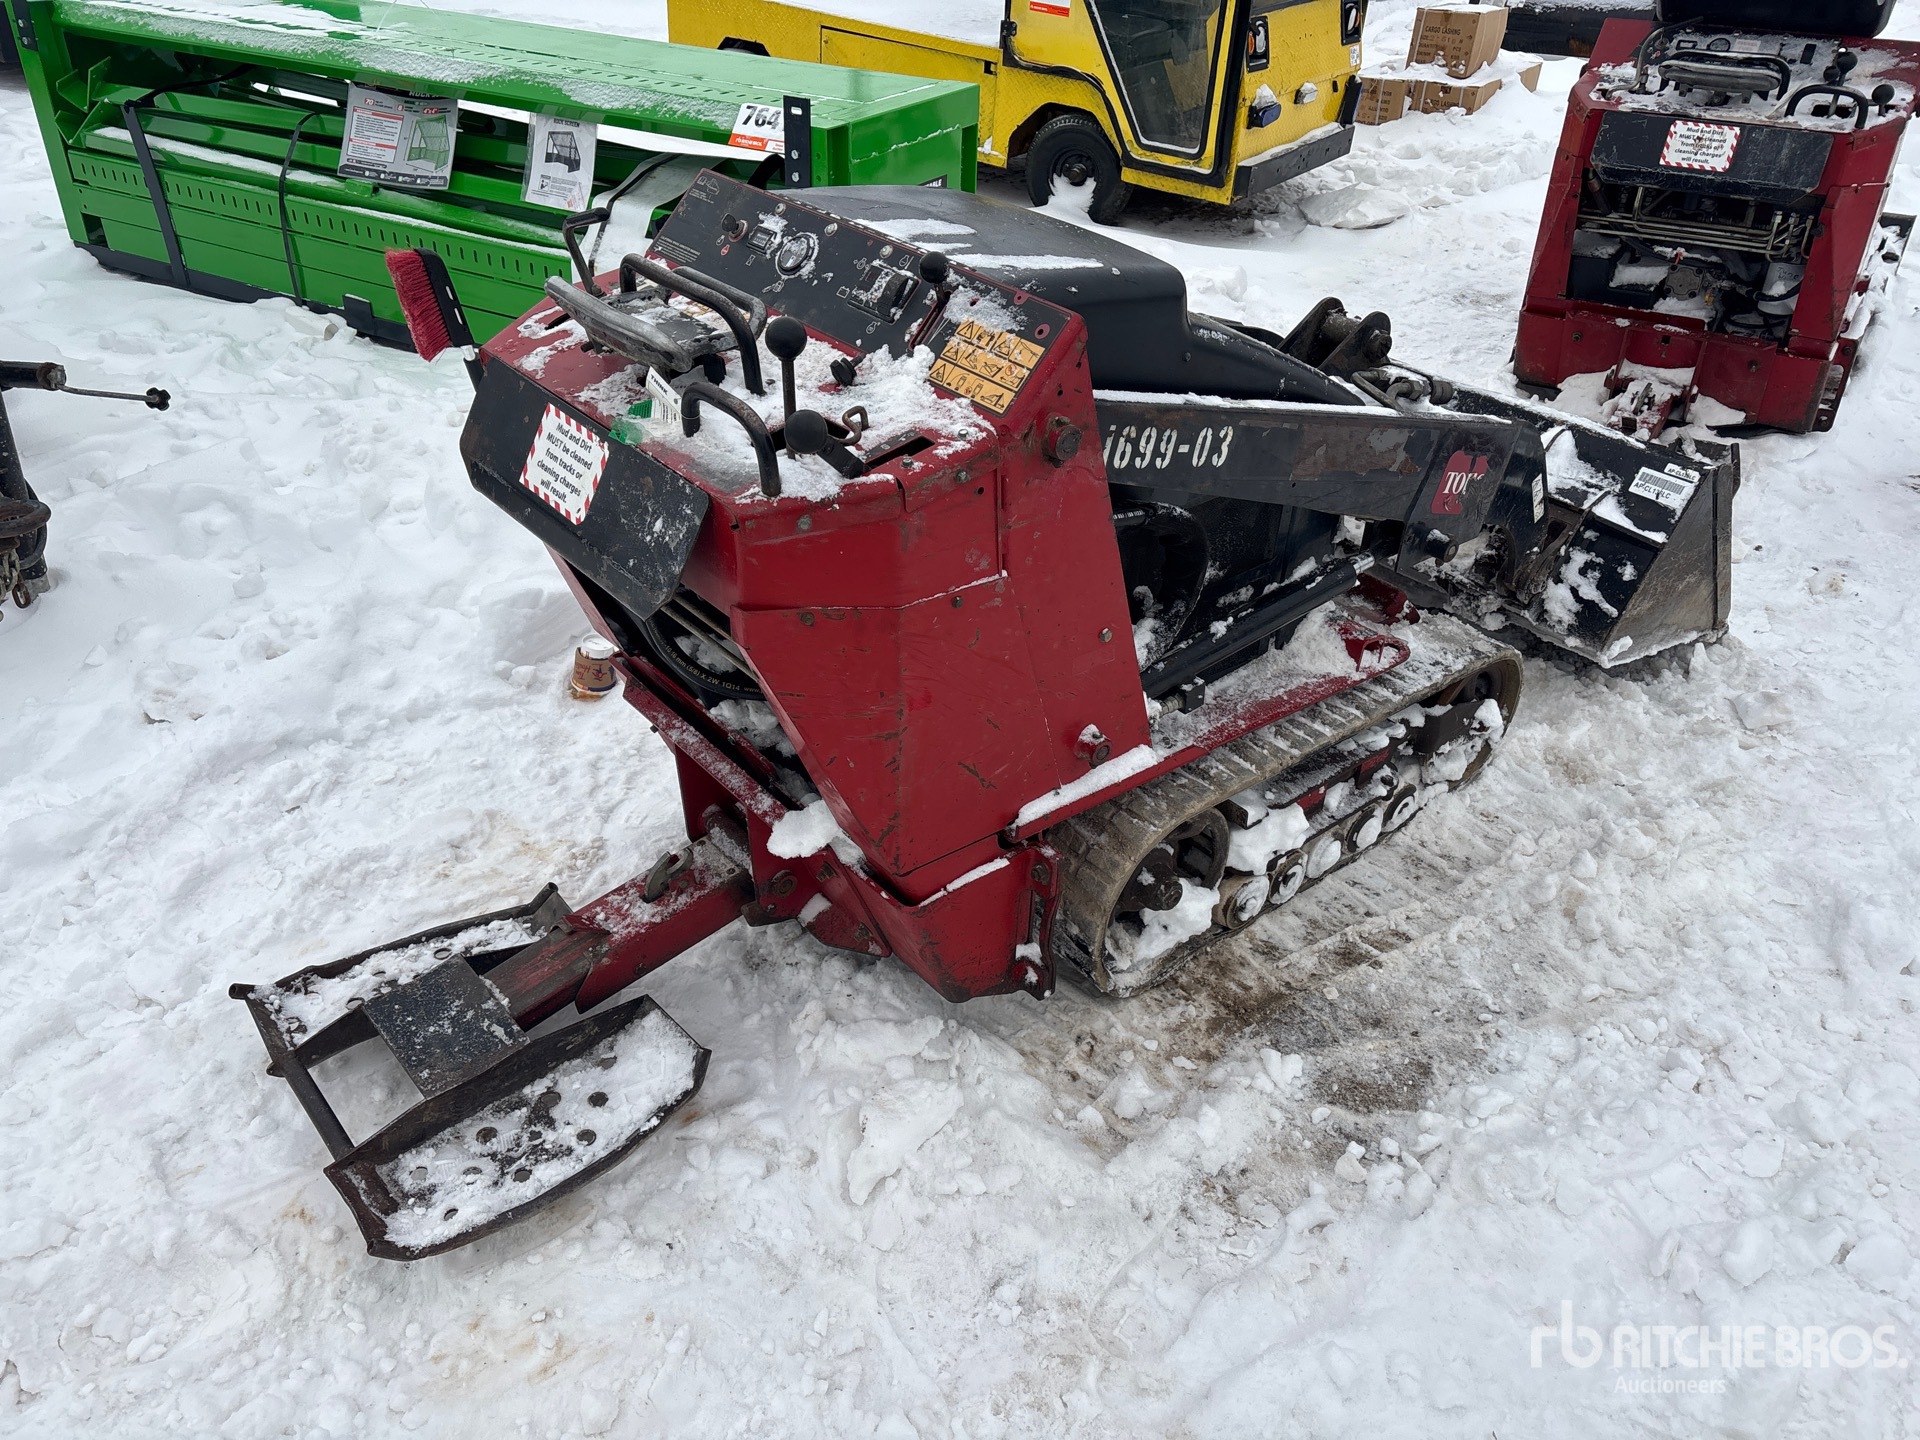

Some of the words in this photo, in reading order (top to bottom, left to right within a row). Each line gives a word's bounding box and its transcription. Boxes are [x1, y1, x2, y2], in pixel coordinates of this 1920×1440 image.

[1441, 27, 1461, 35] LASHING
[742, 105, 781, 129] 764
[651, 374, 668, 395] THINK
[546, 432, 562, 449] MUST
[561, 442, 570, 453] be
[569, 446, 593, 471] cleaned
[556, 422, 569, 437] Mud
[568, 430, 581, 444] and
[580, 438, 593, 454] Dirt
[537, 460, 560, 482] cleaning
[559, 474, 581, 497] charges
[545, 448, 559, 463] from
[559, 457, 576, 475] tracks
[575, 470, 583, 480] or
[540, 477, 550, 490] will
[549, 486, 567, 504] result.
[1442, 472, 1485, 495] TOR
[676, 657, 687, 667] mm
[686, 663, 701, 677] (5/8)
[707, 677, 720, 685] 2W
[722, 681, 740, 691] 1Q14
